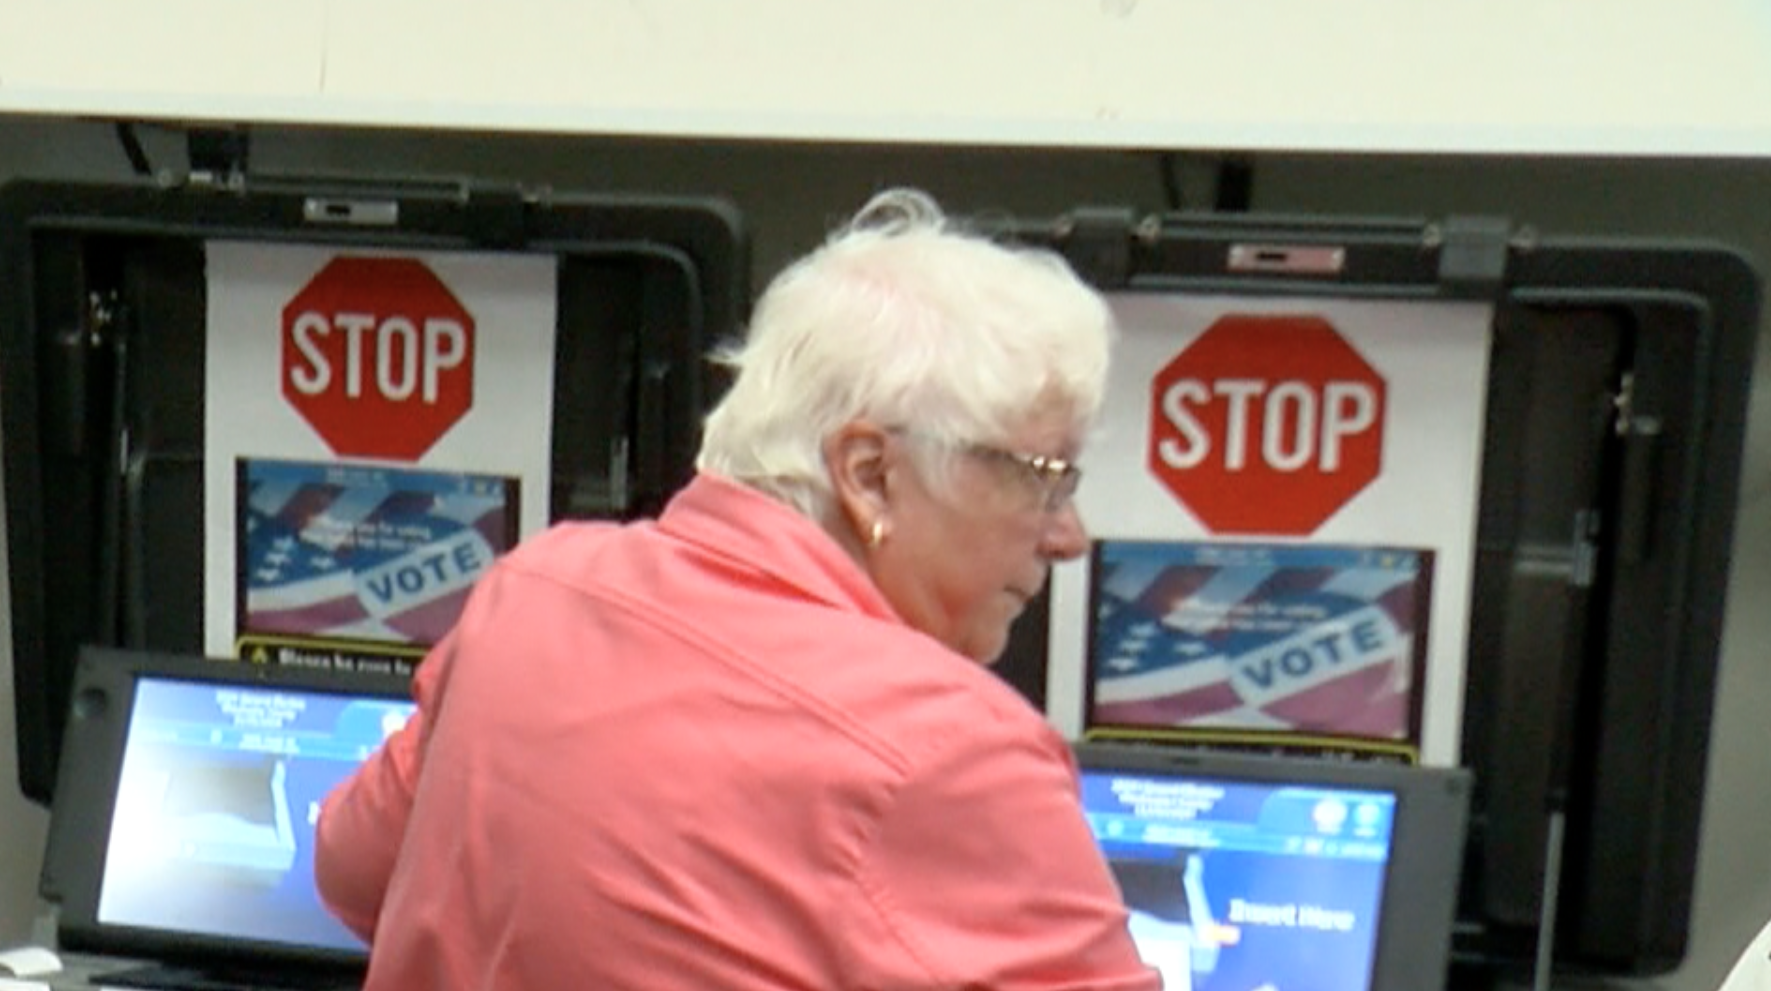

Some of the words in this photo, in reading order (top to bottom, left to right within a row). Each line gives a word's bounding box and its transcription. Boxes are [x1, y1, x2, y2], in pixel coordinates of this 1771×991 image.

[290, 312, 467, 404] STOP
[1158, 378, 1377, 473] STOP
[366, 543, 481, 604] VOTE
[1241, 618, 1386, 690] VOTE
